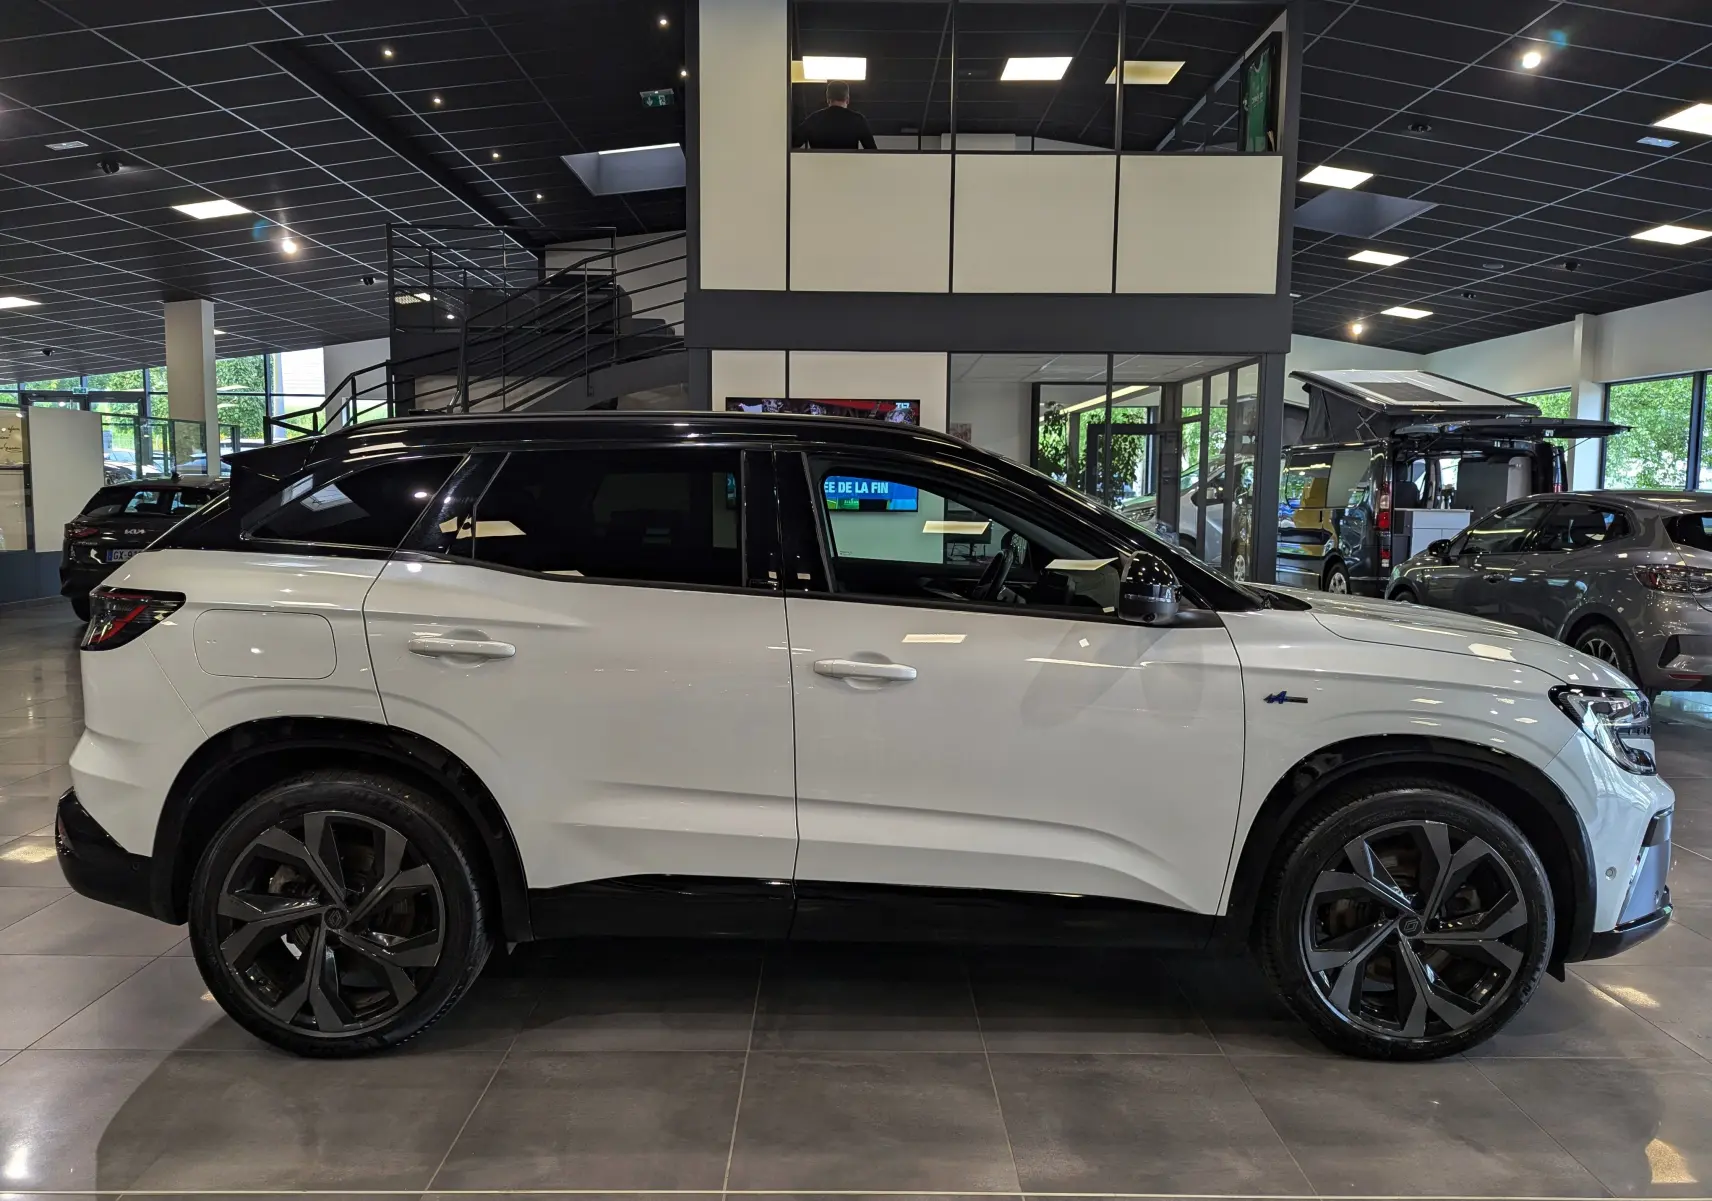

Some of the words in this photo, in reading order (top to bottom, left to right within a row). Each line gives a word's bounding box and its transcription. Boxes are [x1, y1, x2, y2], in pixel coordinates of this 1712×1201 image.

[838, 481, 852, 493] DE
[855, 481, 869, 494] LA
[871, 481, 889, 494] FIN
